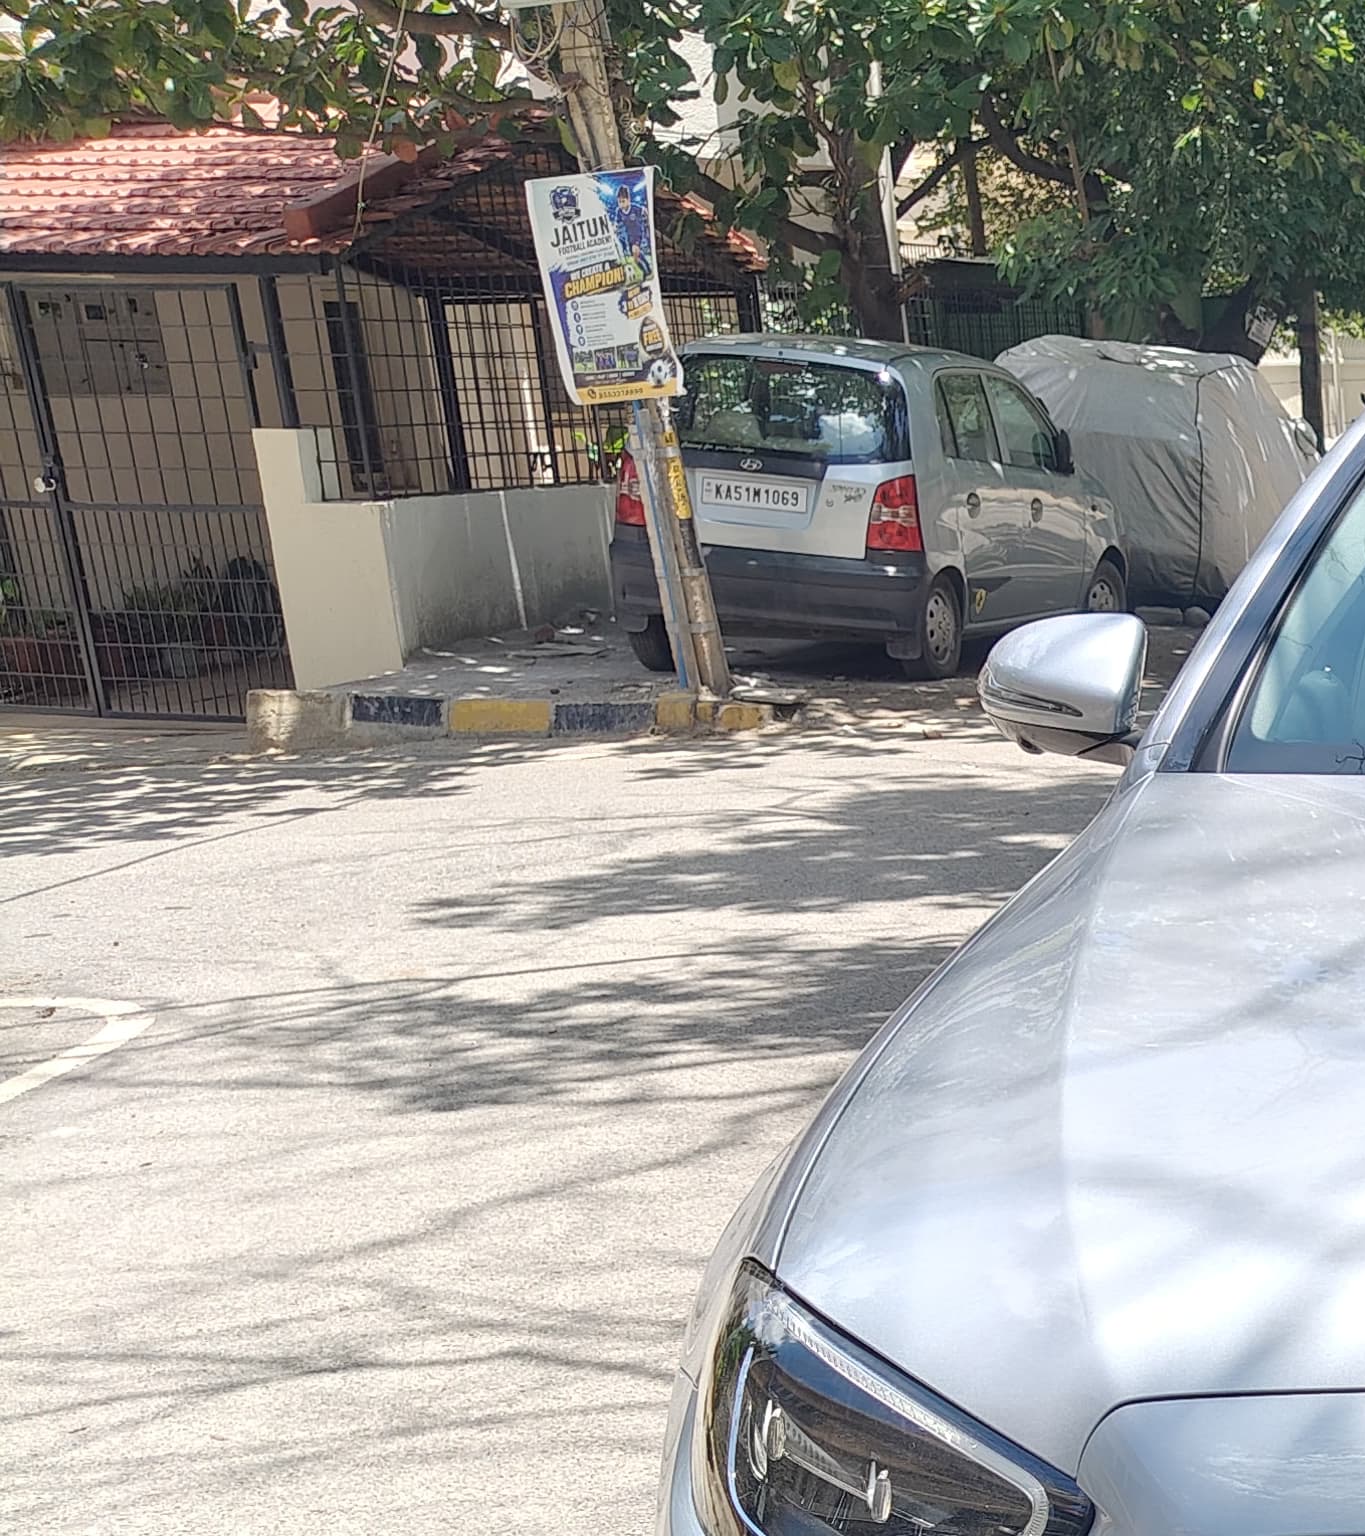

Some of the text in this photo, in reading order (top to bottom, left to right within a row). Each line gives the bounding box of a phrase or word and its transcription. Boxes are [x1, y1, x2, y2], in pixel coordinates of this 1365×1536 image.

[550, 214, 610, 248] JAITUN
[565, 266, 625, 299] CHAMPION!
[714, 483, 799, 507] KA51M1069
